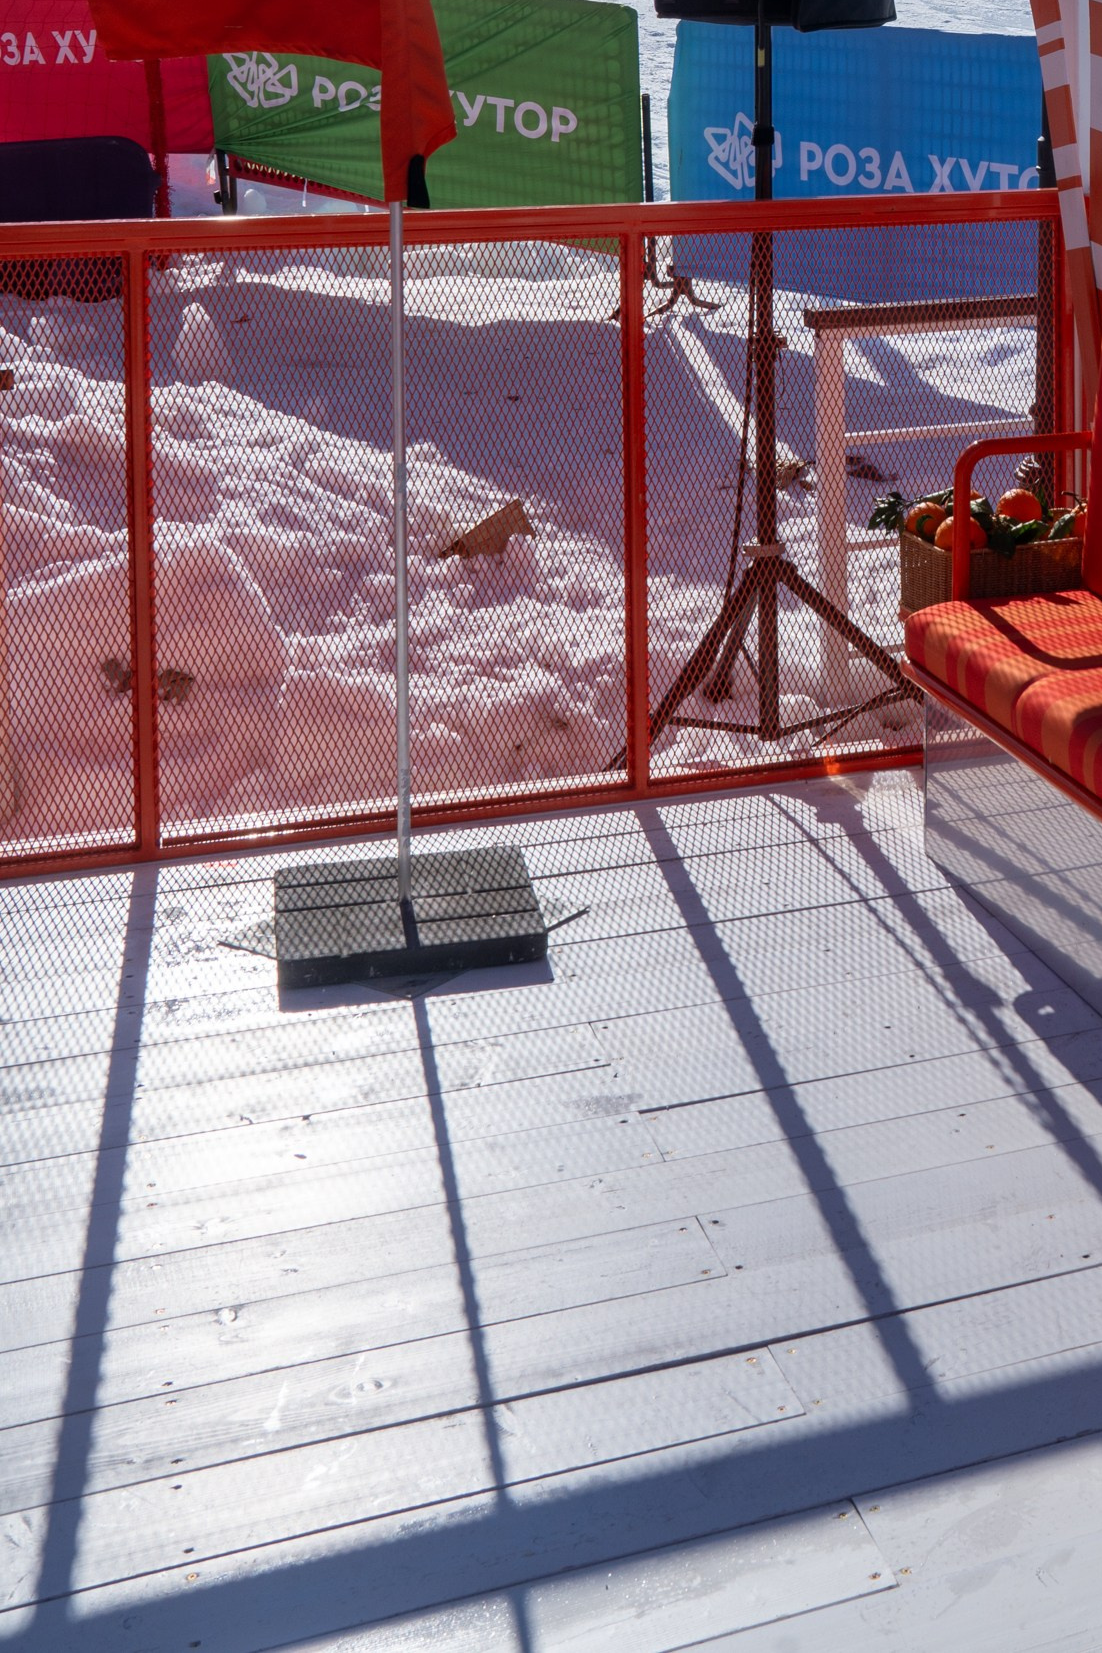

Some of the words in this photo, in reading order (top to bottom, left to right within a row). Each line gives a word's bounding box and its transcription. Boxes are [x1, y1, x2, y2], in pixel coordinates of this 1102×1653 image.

[0, 32, 47, 66] ЗА
[448, 90, 579, 143] УТОР
[799, 141, 914, 193] РОЗА
